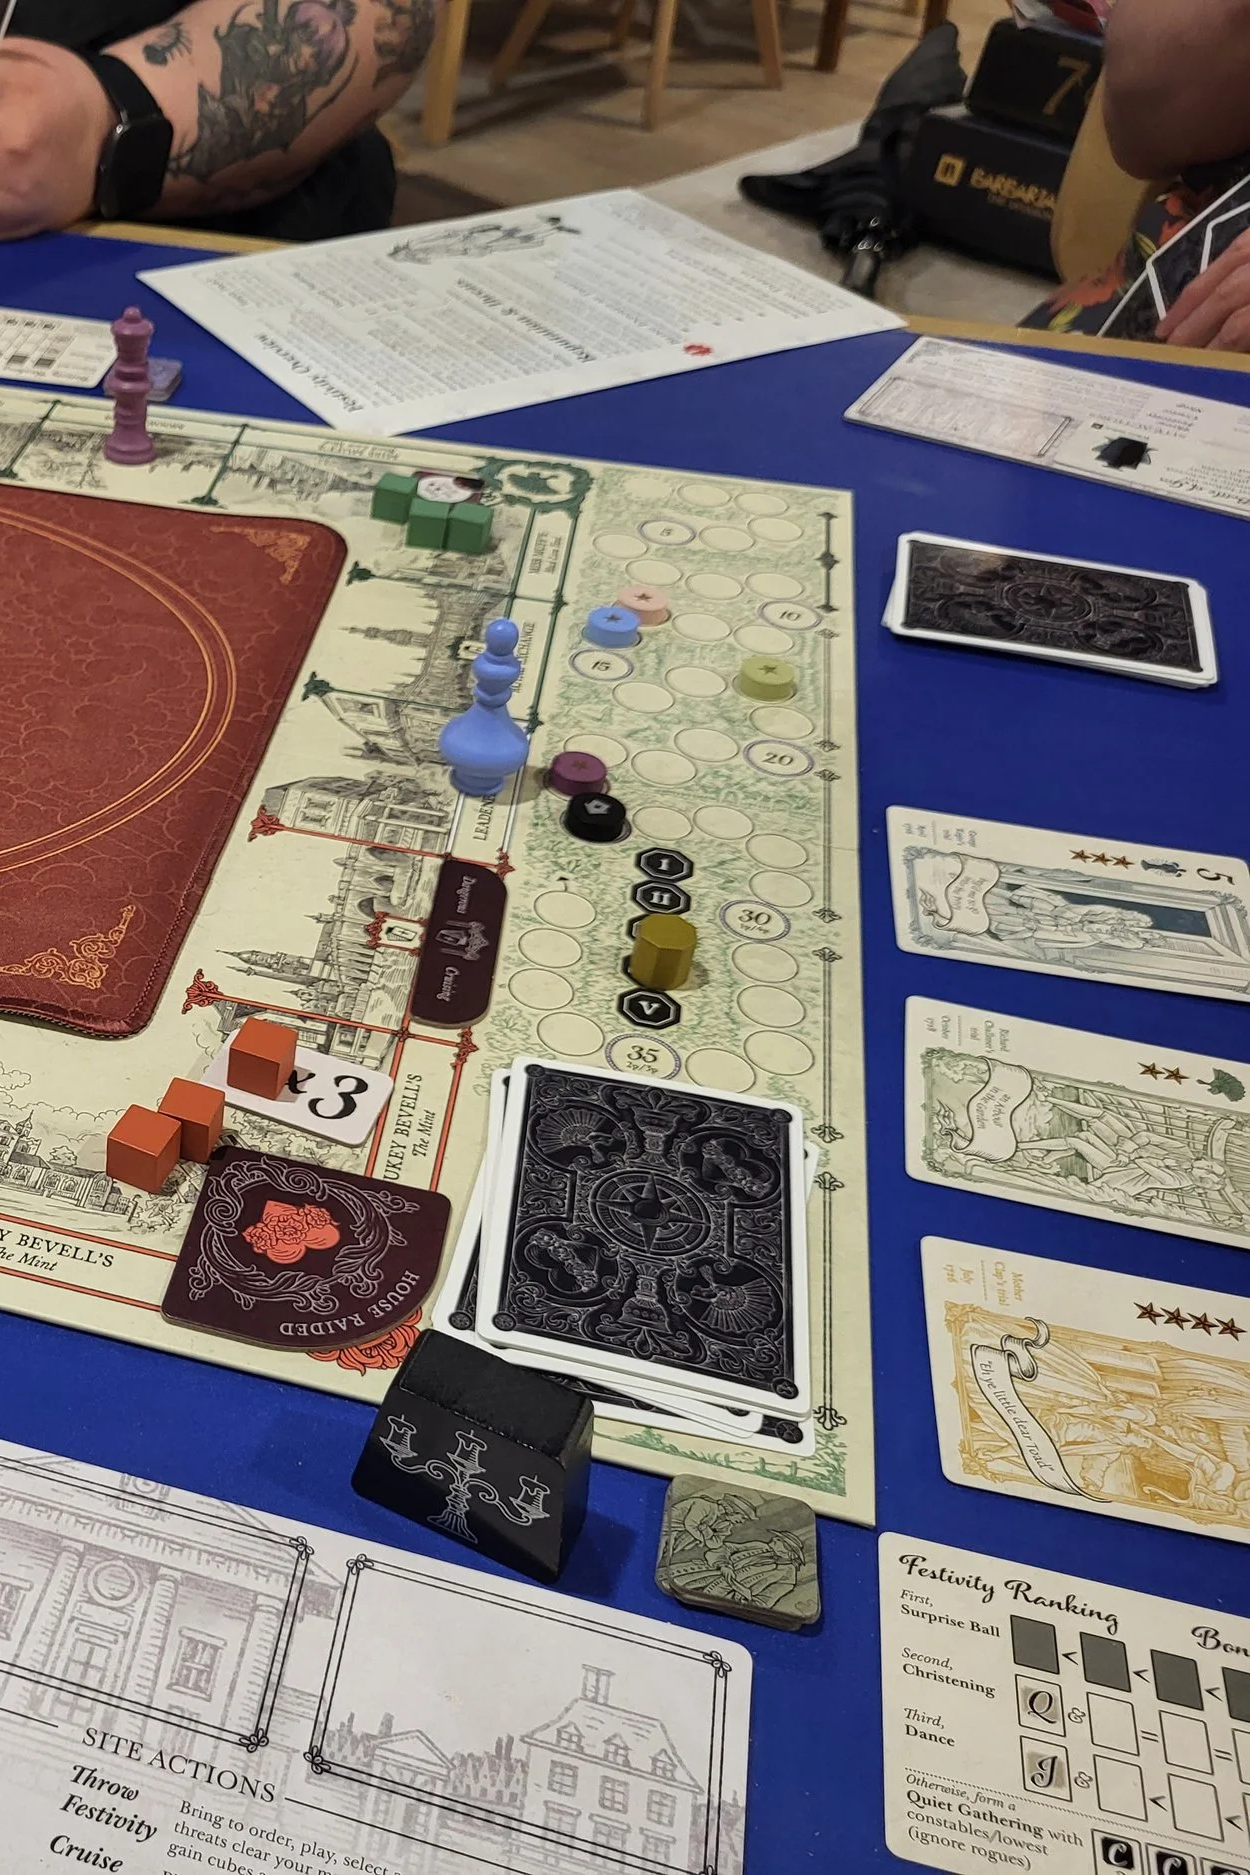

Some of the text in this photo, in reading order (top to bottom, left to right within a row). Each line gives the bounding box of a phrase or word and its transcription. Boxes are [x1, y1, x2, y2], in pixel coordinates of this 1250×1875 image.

[1043, 57, 1091, 115] 7
[779, 610, 801, 622] 10
[590, 660, 612, 672] 15
[762, 751, 794, 767] 20
[1196, 867, 1236, 886] 5
[736, 909, 772, 926] 30
[436, 875, 477, 1002] Dangerous Cruising
[626, 1045, 660, 1063] 35
[284, 1068, 370, 1120] x3
[382, 1072, 424, 1182] UKEY BEVELL'S
[412, 1109, 436, 1157] The Mint
[15, 1232, 116, 1268] BEVELL'S
[17, 1252, 58, 1272] Mint
[993, 1261, 1005, 1289] Clap's
[1012, 1270, 1024, 1302] Mother
[278, 1268, 421, 1337] HOUSE RAIDED
[992, 1388, 1016, 1416] little
[1012, 1412, 1032, 1443] dear
[899, 1553, 1120, 1636] Festivity Ranking
[900, 1588, 934, 1608] First,
[900, 1604, 1002, 1638] Surprise Ball
[901, 1646, 954, 1671] Second,
[902, 1663, 997, 1700] Christening
[904, 1706, 946, 1730] Third,
[1027, 1690, 1058, 1725] Q
[904, 1724, 956, 1748] Dance
[69, 1764, 141, 1802] Throw
[81, 1726, 277, 1804] SITE ACTIONS
[906, 1773, 971, 1801] Otherwise,
[971, 1790, 1007, 1811] form
[59, 1792, 160, 1845] Festivity
[906, 1788, 1085, 1849] Quiet Gathering with
[906, 1808, 1050, 1857] constables/lowest
[49, 1833, 124, 1874] Cruise
[173, 1819, 314, 1875] threats clear your
[179, 1800, 388, 1875] Bring to order, play, select
[907, 1824, 1032, 1872] (ignore rogues)
[166, 1840, 255, 1875] gain cubes
